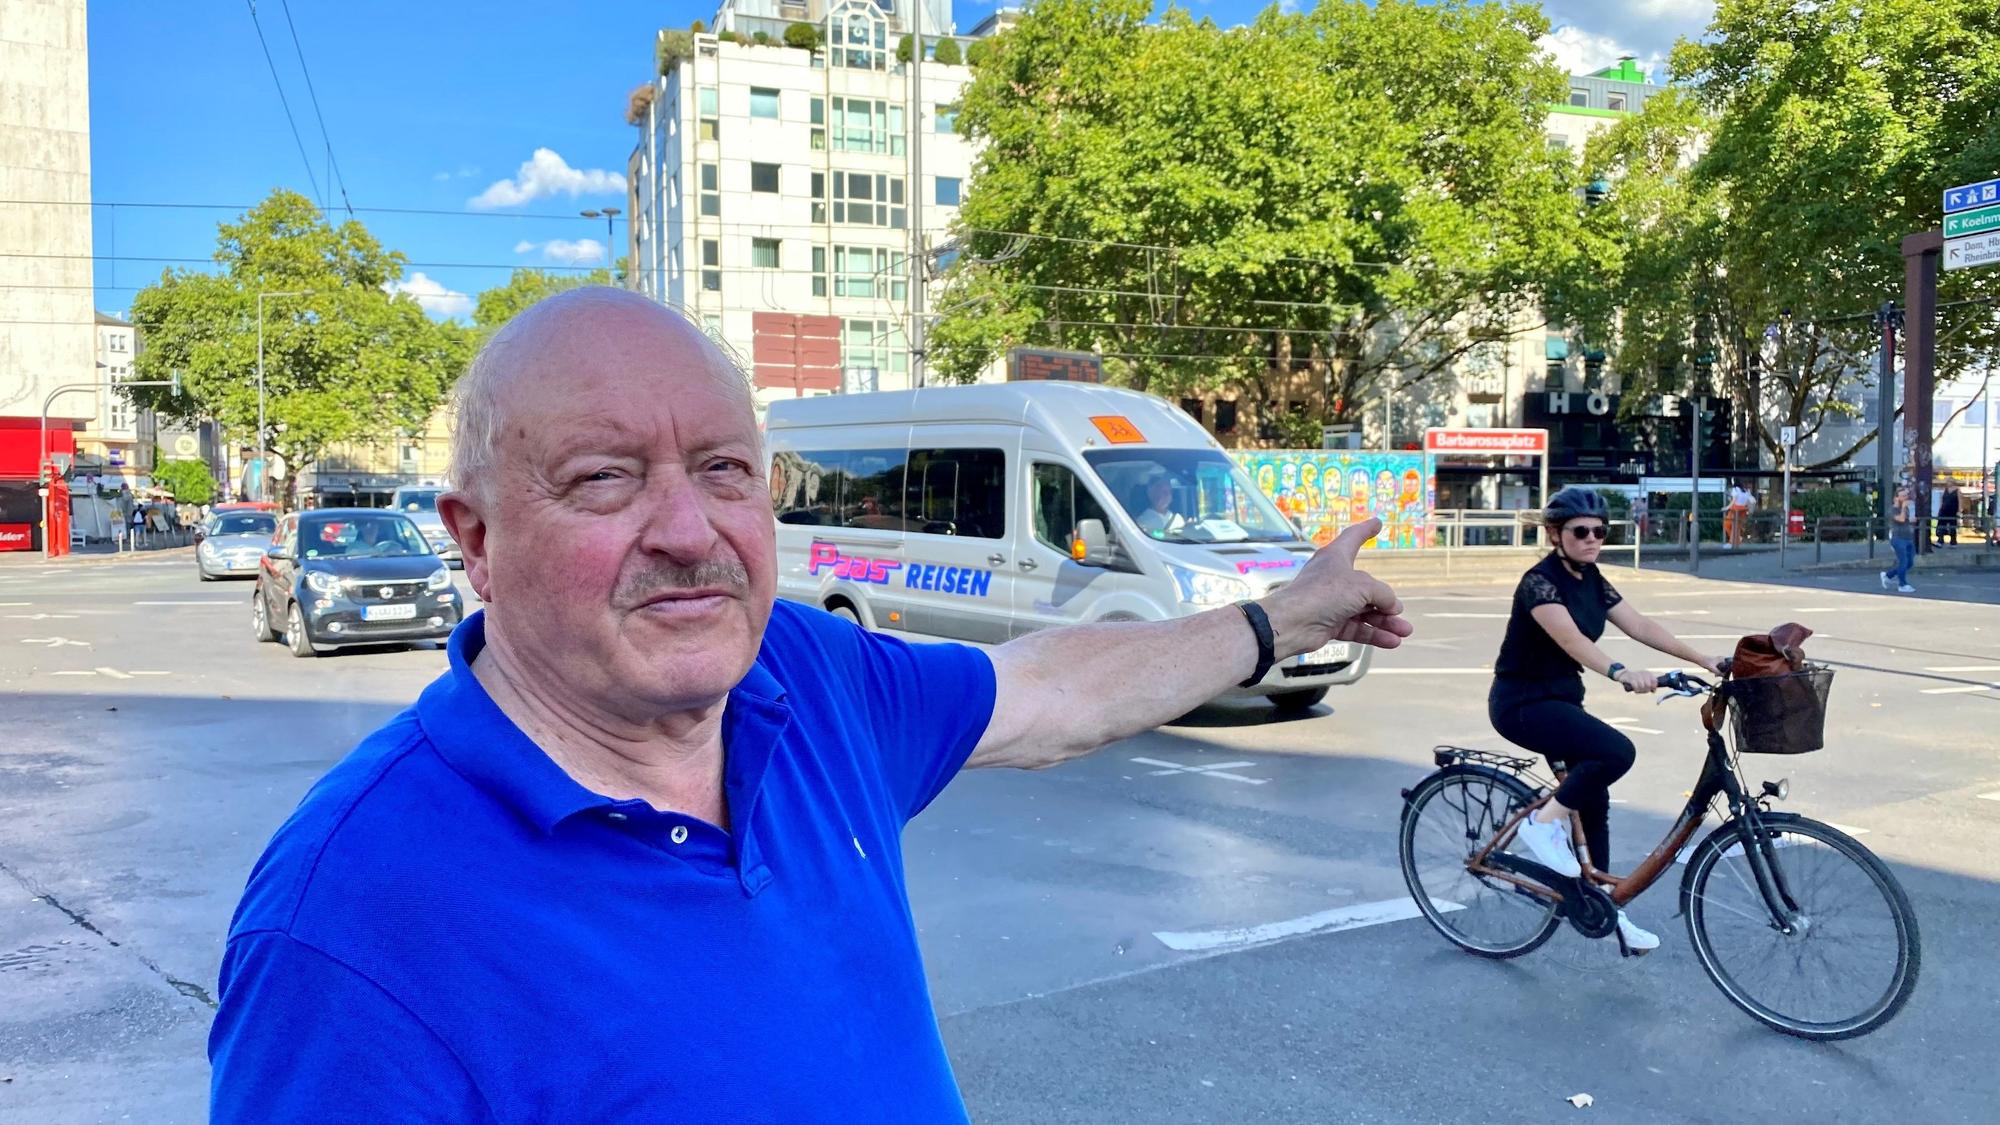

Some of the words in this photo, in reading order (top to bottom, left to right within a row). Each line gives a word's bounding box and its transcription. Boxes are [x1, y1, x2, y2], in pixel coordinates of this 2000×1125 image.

[1964, 241, 1985, 251] Dom,
[1550, 391, 1715, 417] HOEL
[1436, 432, 1536, 449] Barbarossaplatz
[1783, 432, 1790, 443] 2
[809, 541, 902, 585] Paas
[905, 563, 992, 597] REISEN
